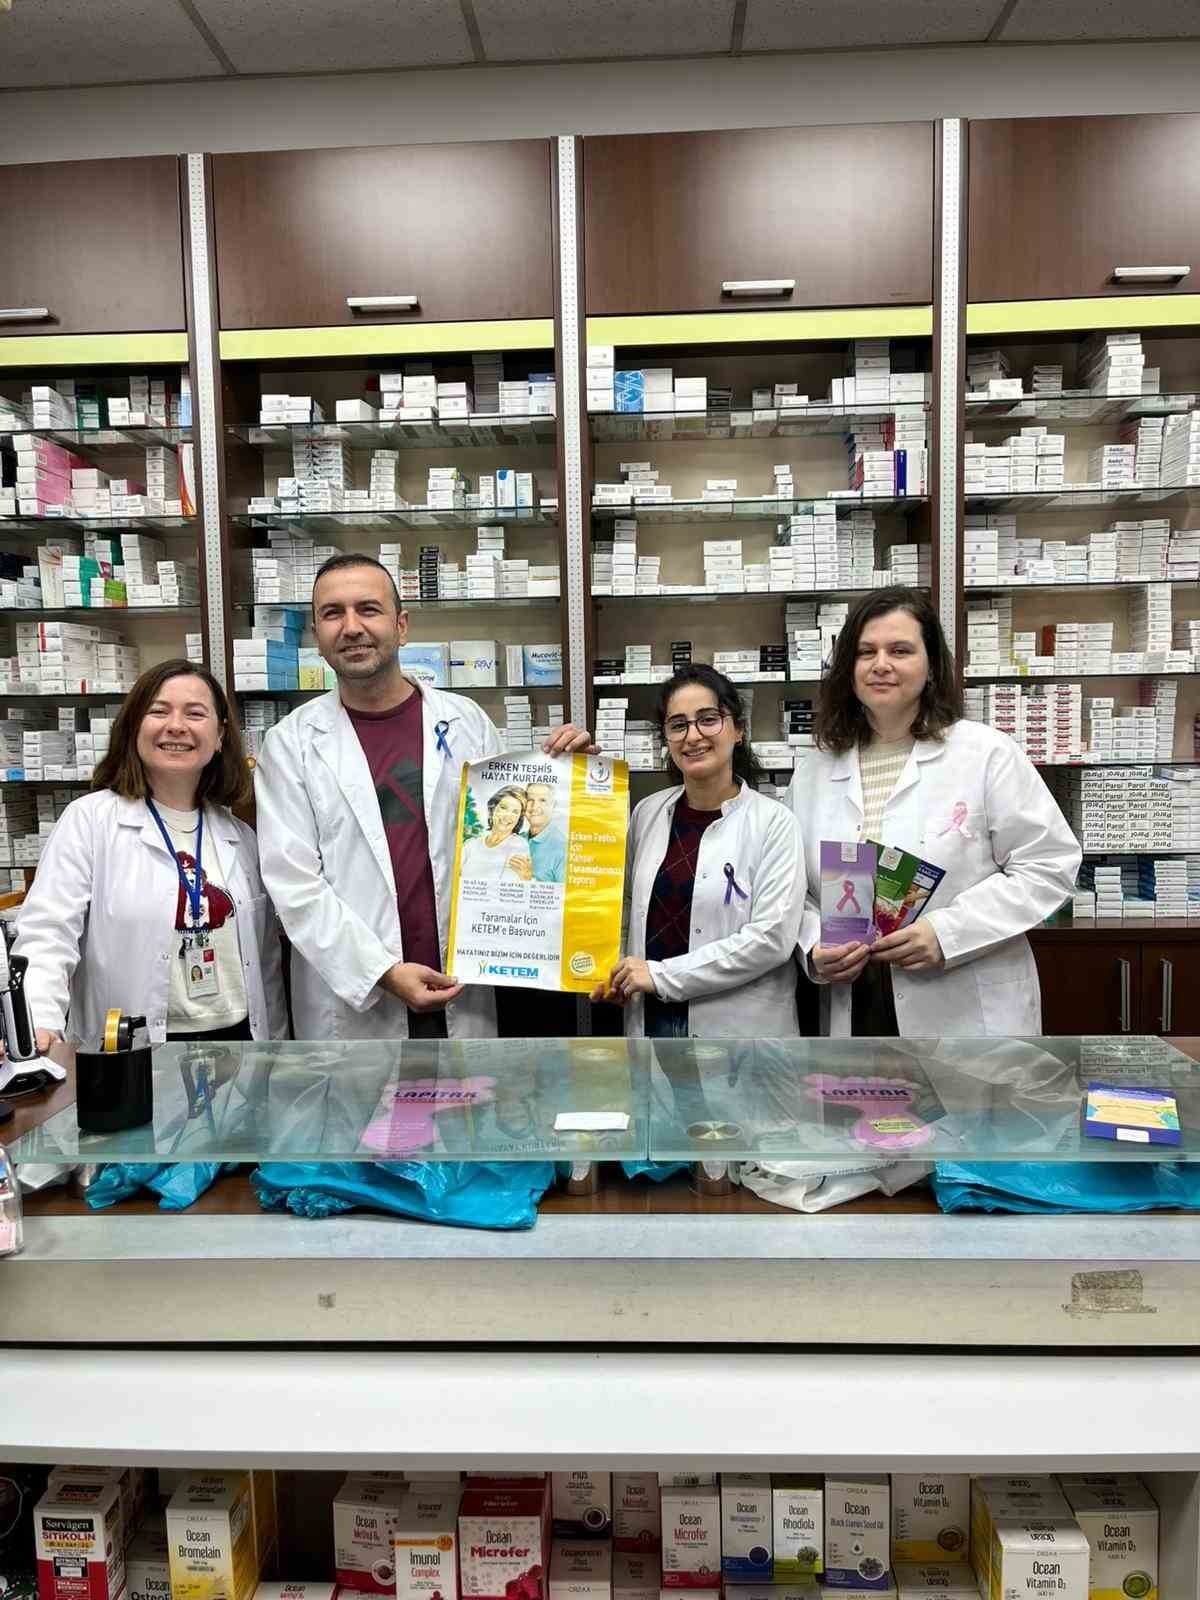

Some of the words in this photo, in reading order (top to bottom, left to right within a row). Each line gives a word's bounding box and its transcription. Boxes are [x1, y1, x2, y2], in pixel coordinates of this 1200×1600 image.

[488, 761, 519, 773] ERKEN
[481, 772, 511, 782] HAYAT
[512, 773, 558, 784] KURTARIR
[481, 911, 522, 925] Taramalar
[471, 923, 507, 935] KETEM'e
[508, 926, 546, 938] Başvurun
[488, 964, 539, 977] KETEM
[736, 1502, 757, 1513] Ocean
[788, 1504, 809, 1515] Ocean
[844, 1502, 870, 1515] Ocean
[356, 1515, 378, 1528] Ocean
[679, 1514, 702, 1525] Ocean
[783, 1518, 815, 1530] Rhodiola
[186, 1529, 210, 1542] Ocean
[674, 1527, 708, 1540] Microfer
[1104, 1523, 1130, 1537] Ocean
[486, 1530, 512, 1545] Ocean
[178, 1545, 221, 1559] Bromelain
[471, 1546, 530, 1558] Microfer
[1098, 1540, 1127, 1551] Vitamin
[411, 1566, 440, 1579] Complex
[1032, 1560, 1060, 1575] Ocean
[1026, 1577, 1056, 1589] Vitamin
